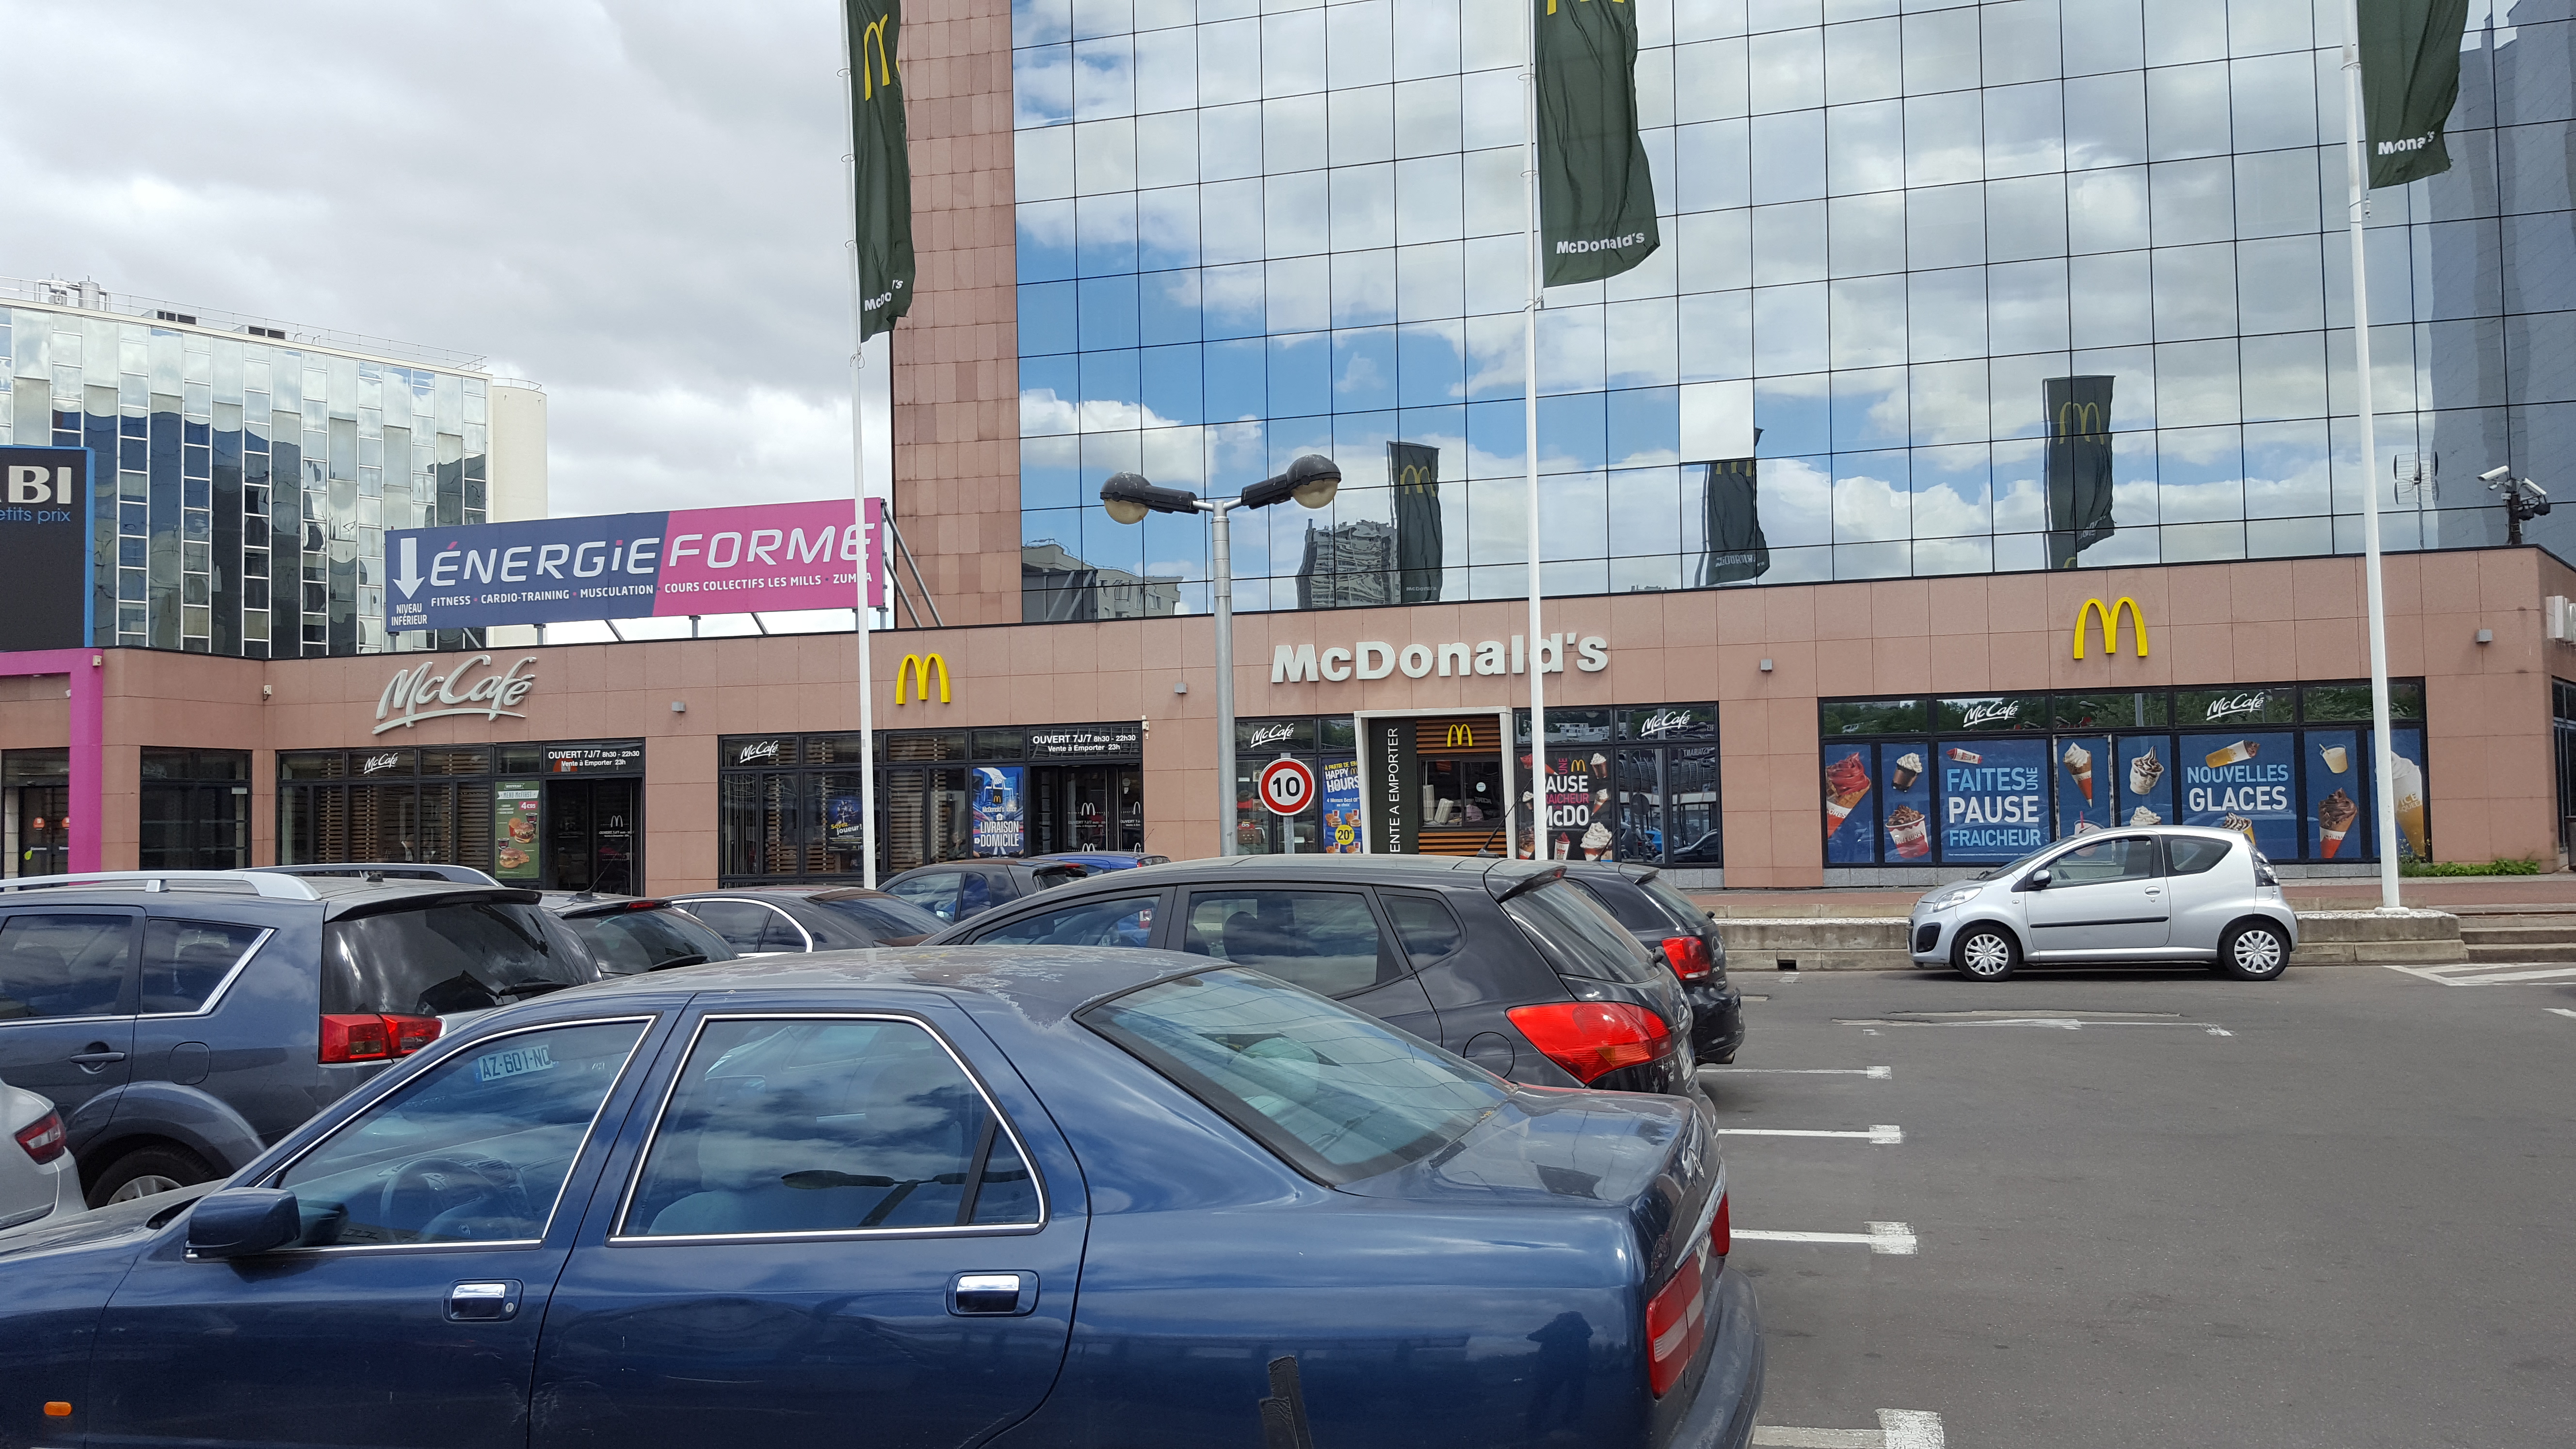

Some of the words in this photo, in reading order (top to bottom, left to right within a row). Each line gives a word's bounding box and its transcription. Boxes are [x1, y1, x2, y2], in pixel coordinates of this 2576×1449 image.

[1556, 232, 1645, 254] McDonald's
[0, 465, 72, 504] BI
[38, 508, 71, 524] prix
[669, 523, 875, 568] FORME
[431, 596, 471, 607] FITNESS
[481, 590, 569, 604] CARDIO-TRAINING
[580, 585, 653, 598] MUSCULATION
[665, 582, 700, 593] COURS
[703, 578, 765, 591] COLLECTIFS
[768, 577, 787, 588] LES
[790, 575, 821, 587] MILLS
[833, 572, 872, 584] ZUMA
[396, 603, 422, 614] NIVEAU
[391, 614, 428, 626] INFÉRIEUR
[1272, 632, 1609, 683] McDonald's
[372, 655, 537, 731] McCafé
[1964, 700, 2019, 727] McCafé
[2206, 692, 2264, 721] McCafé
[1641, 710, 1690, 737] McCafé
[1033, 735, 1070, 744] OUVERT
[1073, 734, 1092, 743] 7J/7
[1251, 724, 1294, 748] McCafé
[548, 751, 581, 759] OUVERT
[584, 750, 601, 758] 7J/7
[740, 740, 778, 764] McCafé
[364, 752, 399, 774] McCafé
[1387, 728, 1400, 802] EMPORTER
[1558, 757, 1568, 774] UNE
[1325, 768, 1349, 780] HAPPY
[1326, 776, 1359, 793] HOURS
[1545, 775, 1589, 793] AUSE
[1947, 767, 2026, 792] FAITES
[2027, 767, 2038, 790] UNE
[2187, 764, 2289, 784] NOUVELLES
[1272, 776, 1300, 797] 10
[1546, 792, 1590, 804] RAICHEUR
[2189, 786, 2287, 812] GLACES
[2400, 792, 2418, 806] ICE
[1389, 805, 1400, 815] A
[1948, 795, 2039, 823] PAUSE
[981, 821, 1019, 834] LIVRAISON
[1389, 818, 1401, 853] ENTE
[1895, 829, 1925, 845] McFLURRY
[1949, 829, 2042, 847] FRAICHEUR
[981, 834, 1019, 847] DOMICILE
